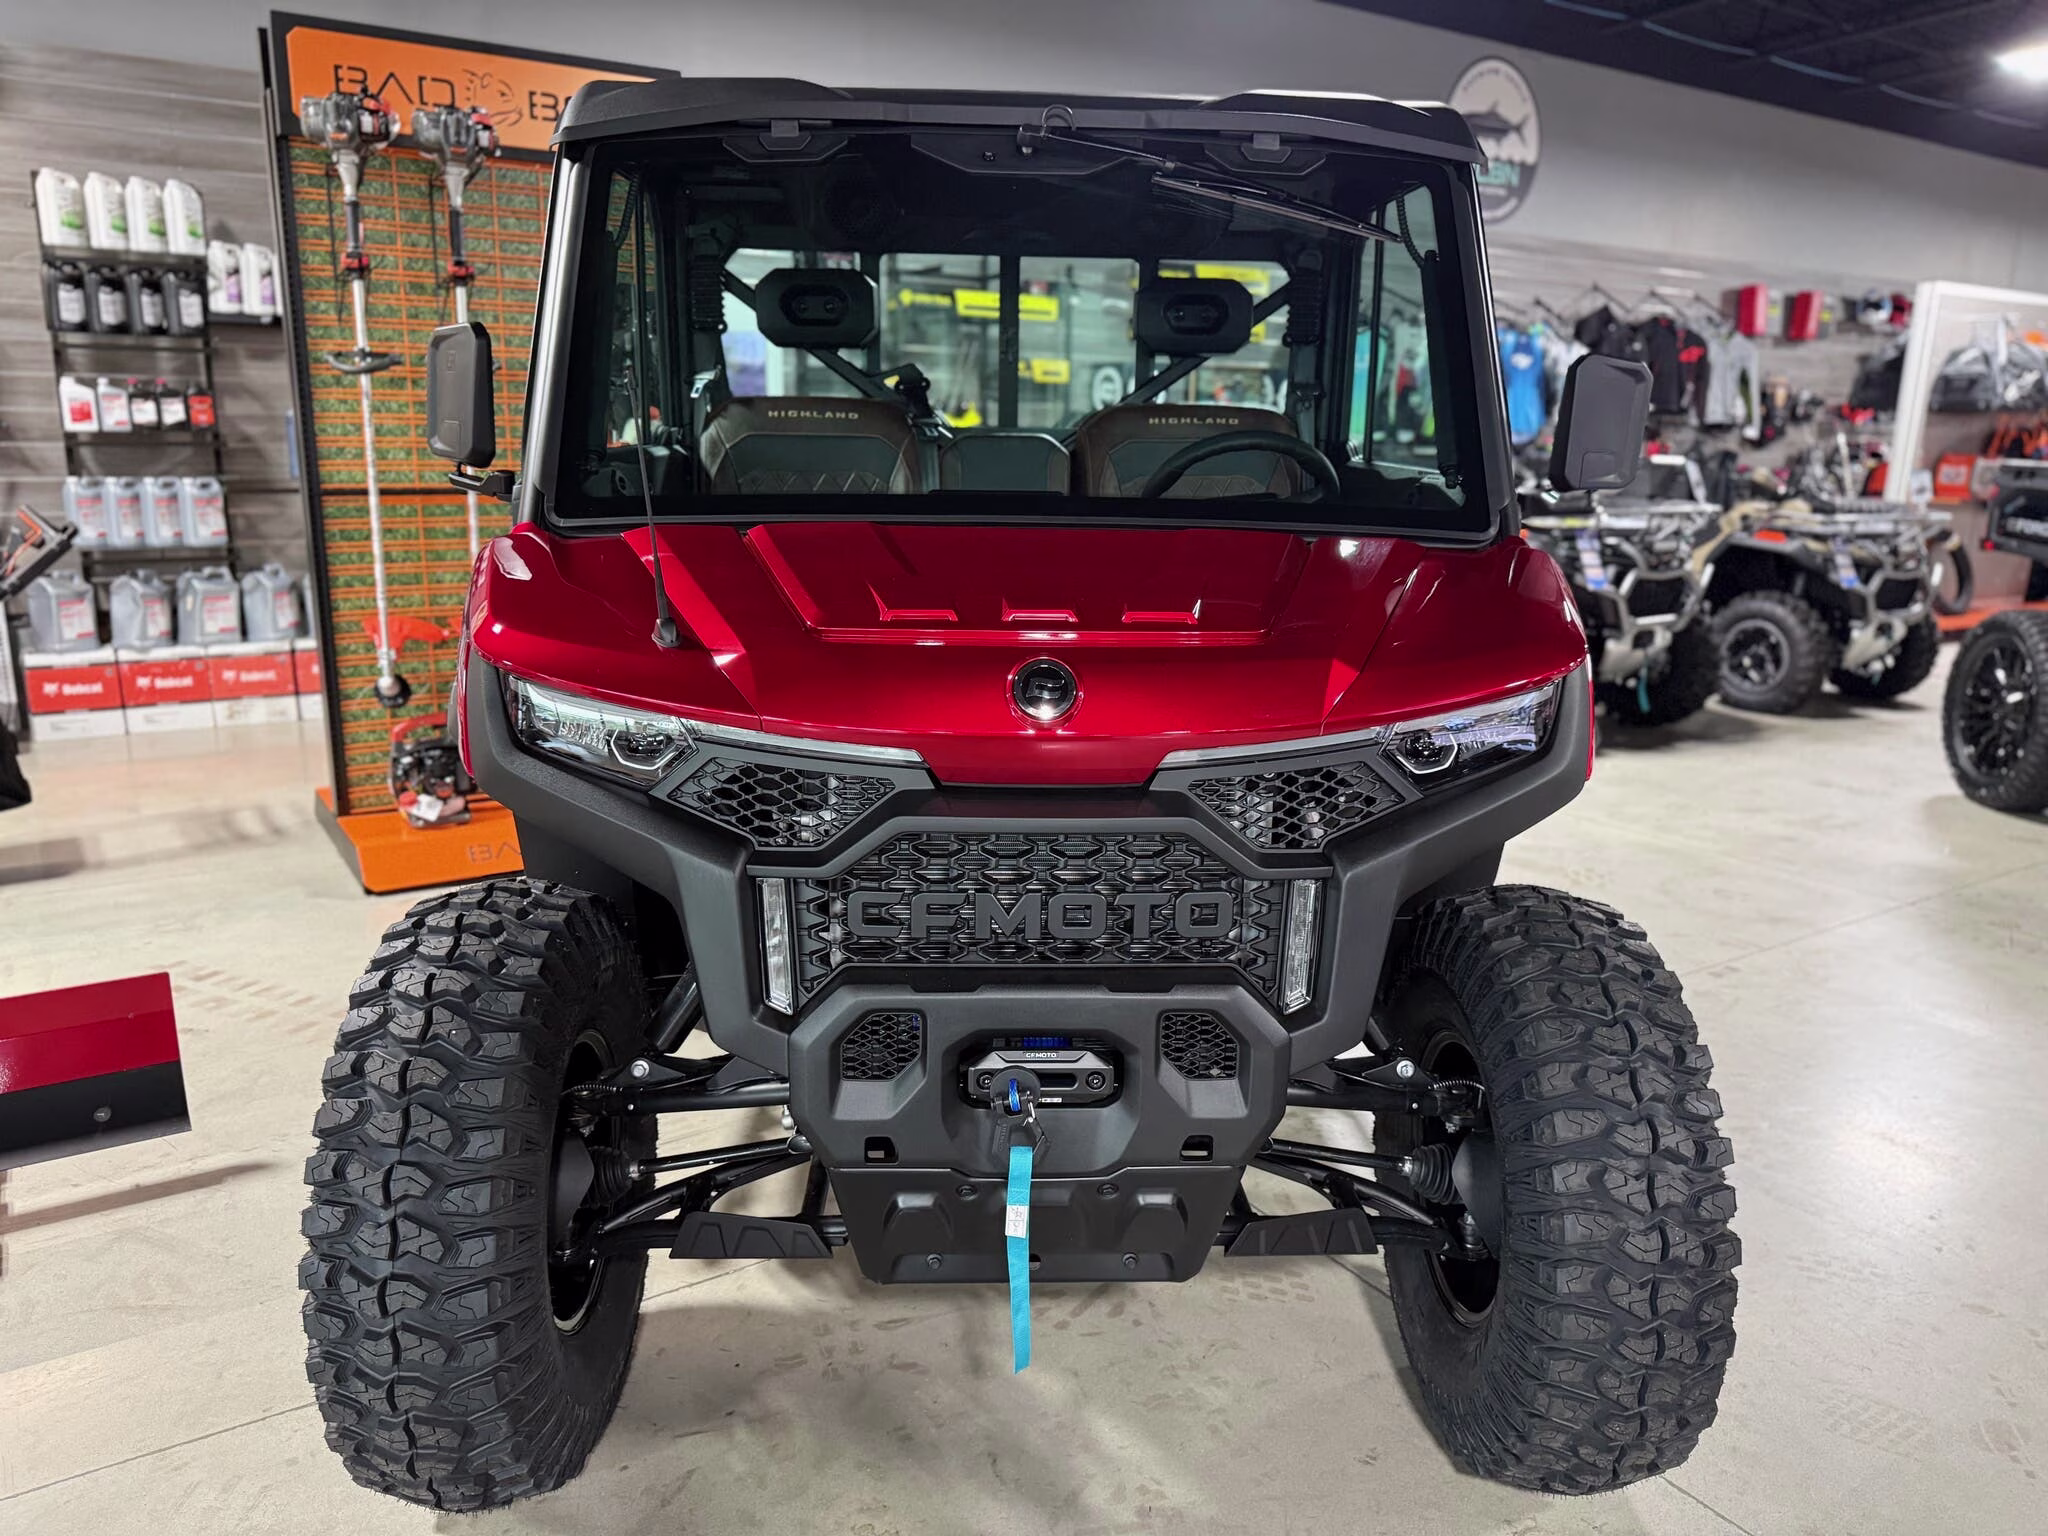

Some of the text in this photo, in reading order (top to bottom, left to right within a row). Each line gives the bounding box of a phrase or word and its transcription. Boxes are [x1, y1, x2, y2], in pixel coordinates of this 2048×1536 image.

[334, 64, 455, 108] BAD
[768, 410, 859, 420] HIGHLAND
[1148, 417, 1239, 425] HIGHLAND
[61, 682, 103, 696] Bobcat
[846, 890, 1235, 940] CFMOTO
[1025, 1051, 1058, 1059] CFMOTO
